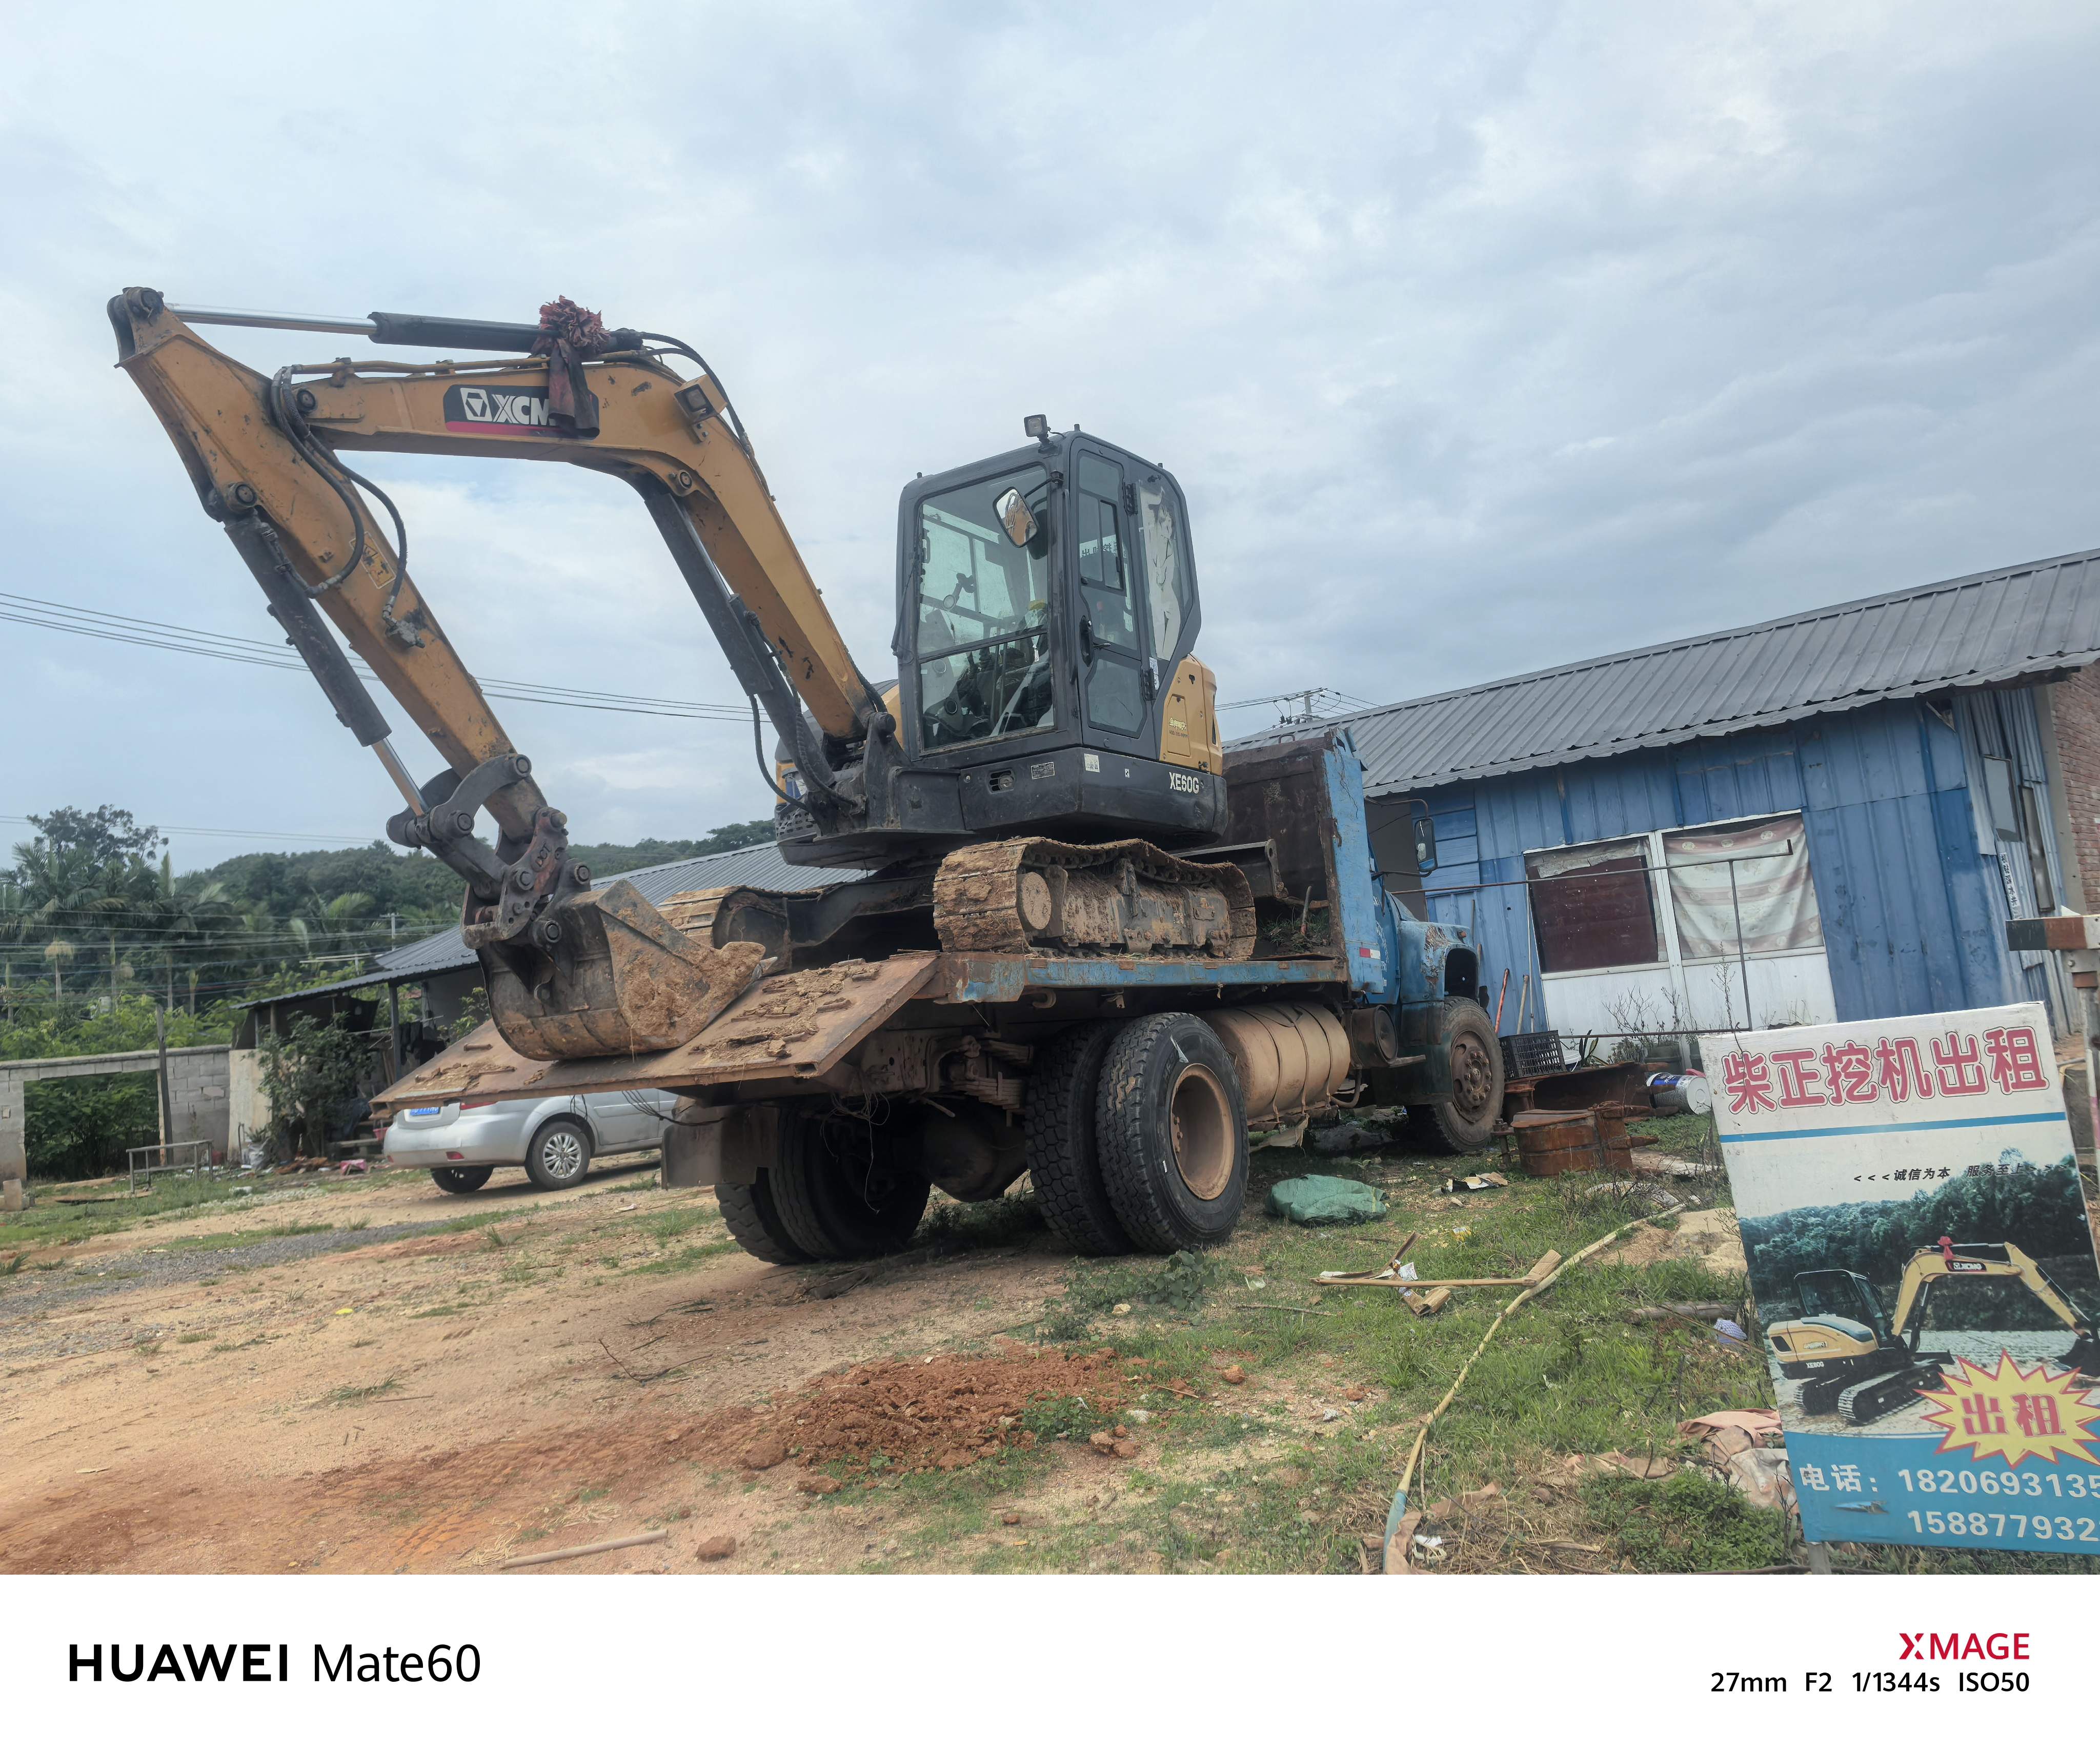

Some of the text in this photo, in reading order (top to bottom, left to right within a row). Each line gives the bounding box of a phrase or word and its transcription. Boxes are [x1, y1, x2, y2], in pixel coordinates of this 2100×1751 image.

[492, 394, 556, 426] XCM
[1169, 772, 1199, 794] XE60G
[1722, 1027, 2049, 1114] 柴正挖机出租
[1894, 1163, 2025, 1181] 诚信为本 服务至上
[1961, 1392, 2067, 1437] 出租
[1908, 1511, 2100, 1542] 158877932
